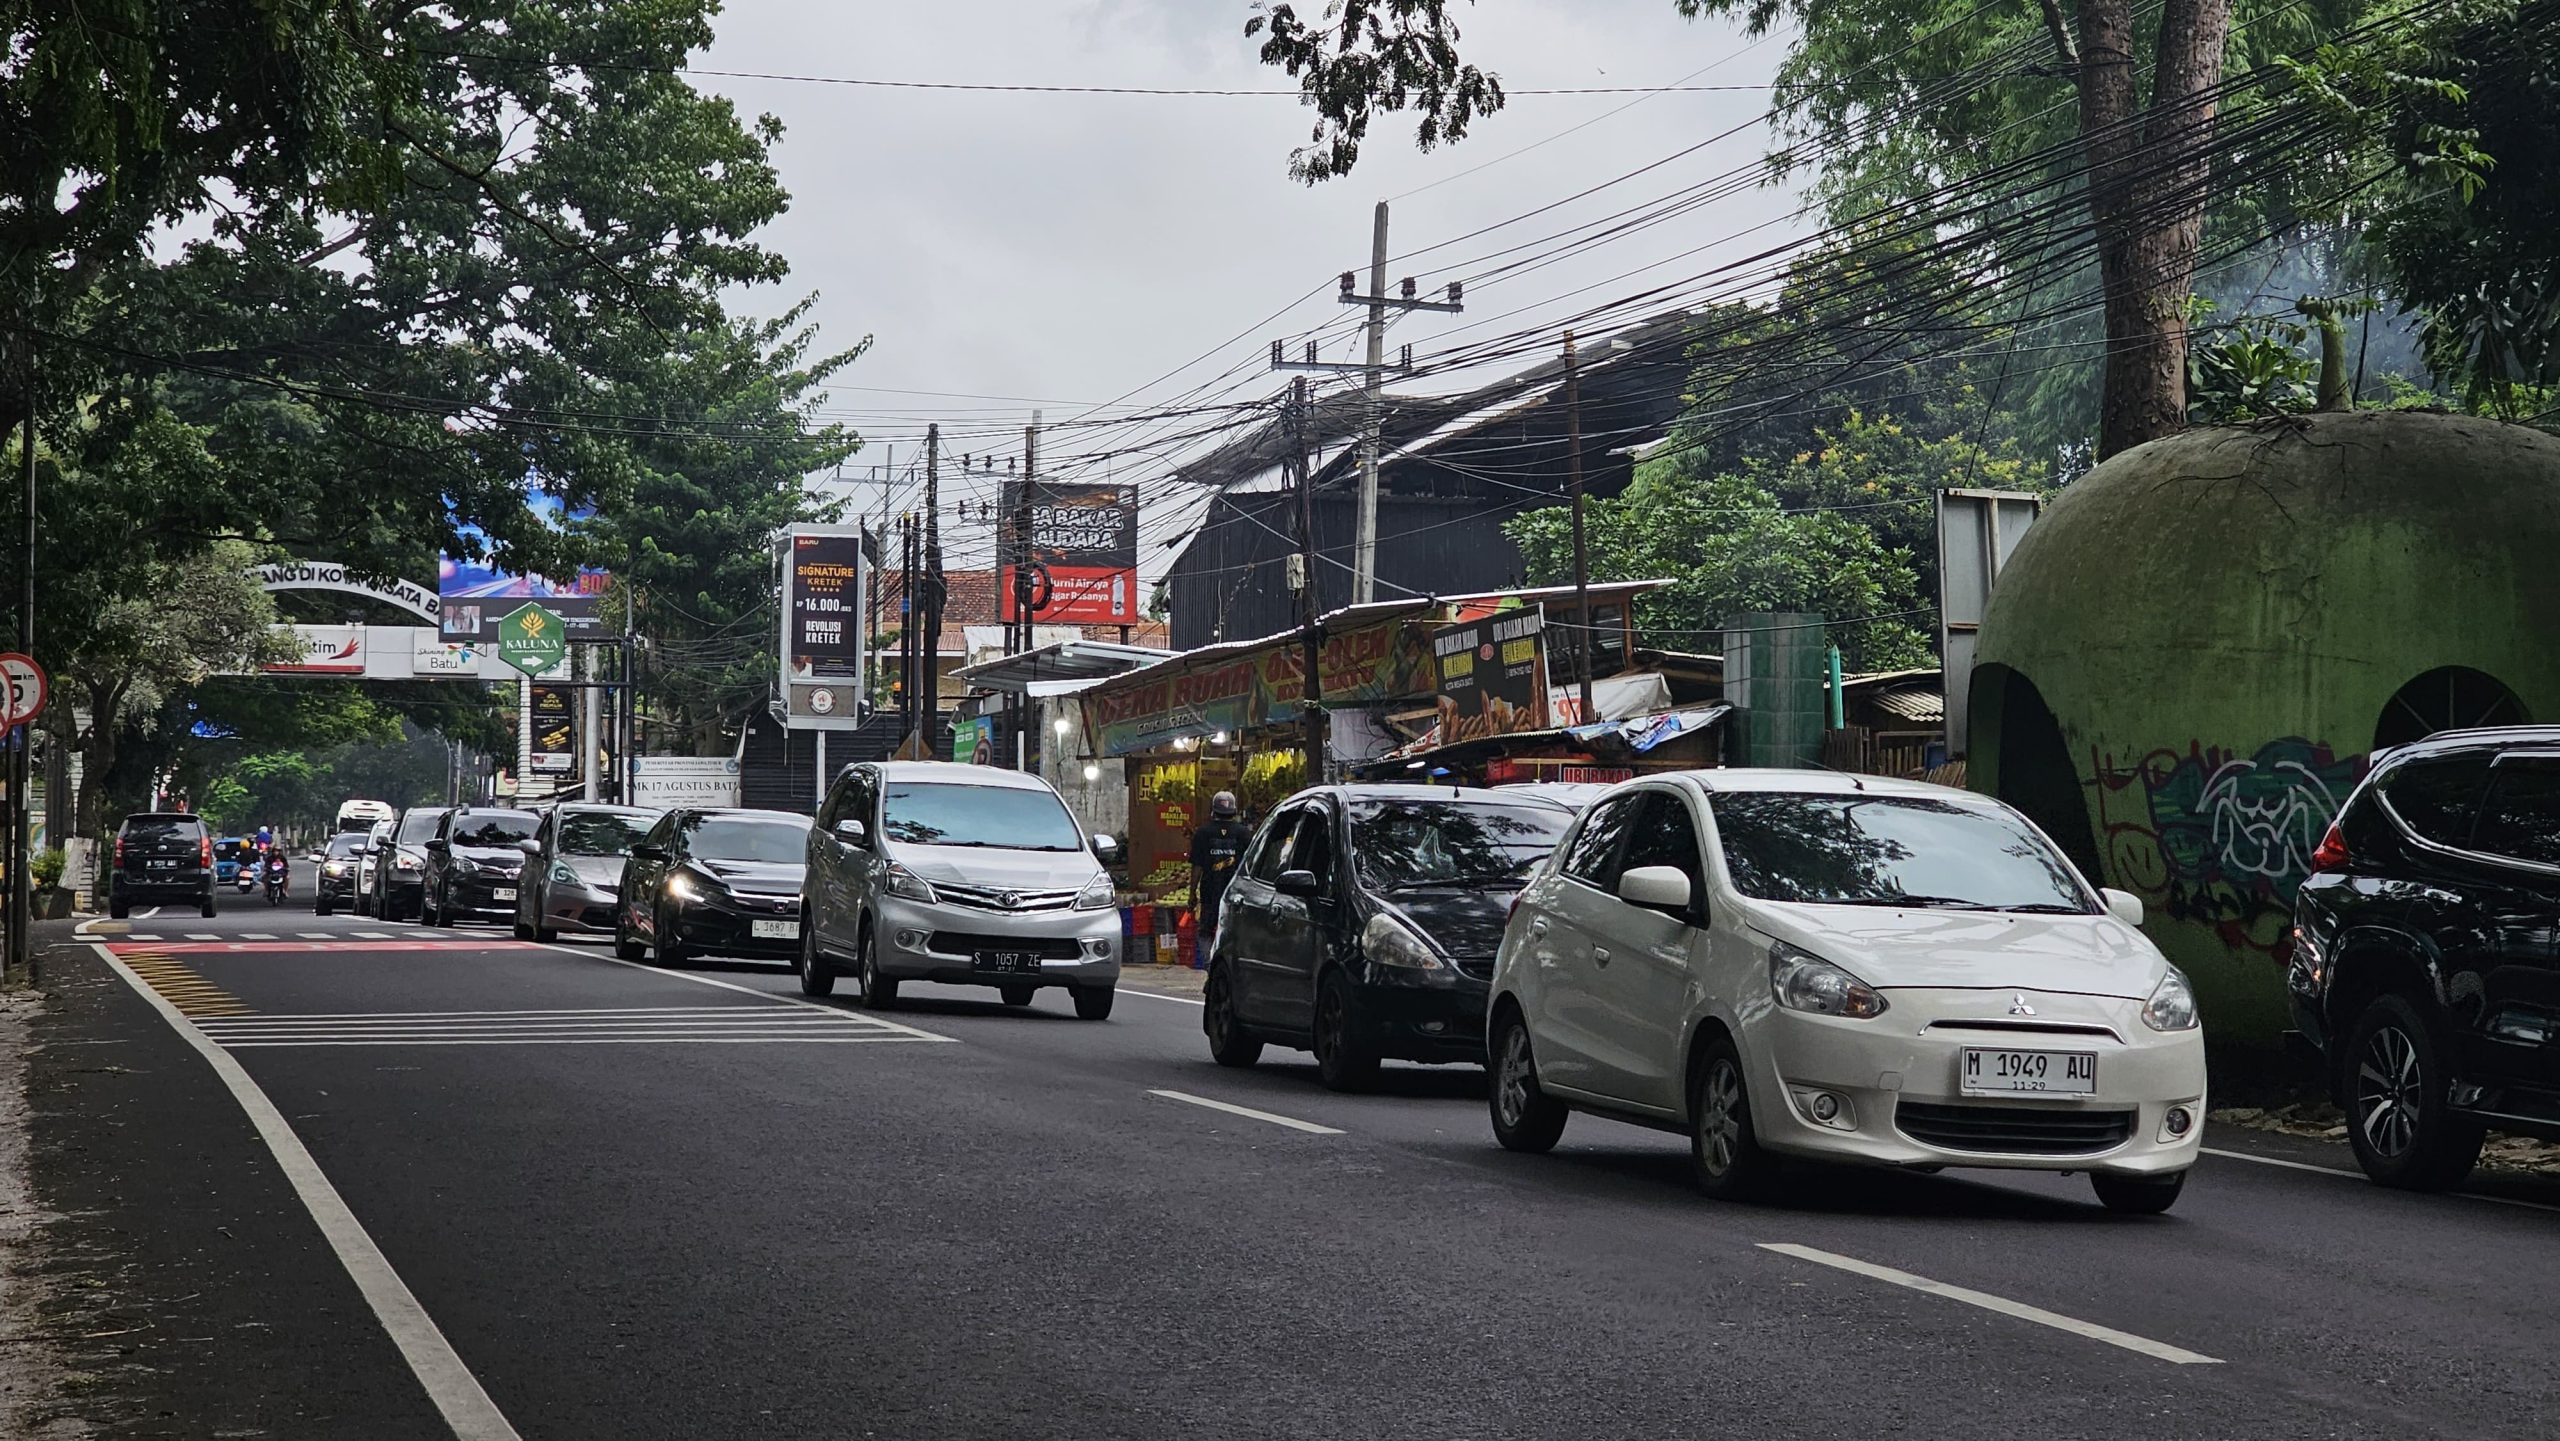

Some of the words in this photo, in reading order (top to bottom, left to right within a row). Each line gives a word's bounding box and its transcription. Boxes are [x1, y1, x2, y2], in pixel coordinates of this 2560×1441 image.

[1055, 508, 1122, 529] BAKAR
[797, 566, 854, 577] SIGNATURE
[807, 577, 843, 586] KRETEK
[301, 567, 315, 581] DI
[425, 598, 440, 616] B
[805, 597, 840, 611] 16.000
[805, 620, 842, 632] REVOLUSI
[805, 632, 841, 644] KRETEK
[506, 640, 559, 649] KALUNA
[430, 657, 458, 669] Batu
[1563, 767, 1588, 784] UBI
[652, 781, 662, 791] 17
[663, 781, 712, 791] AGUSTUS
[754, 921, 759, 931] L
[974, 951, 981, 965] S
[995, 952, 1019, 966] 1057
[1027, 953, 1040, 967] ZE
[1967, 1052, 1980, 1076] M
[1996, 1053, 2048, 1078] 1949
[2066, 1056, 2092, 1080] AU
